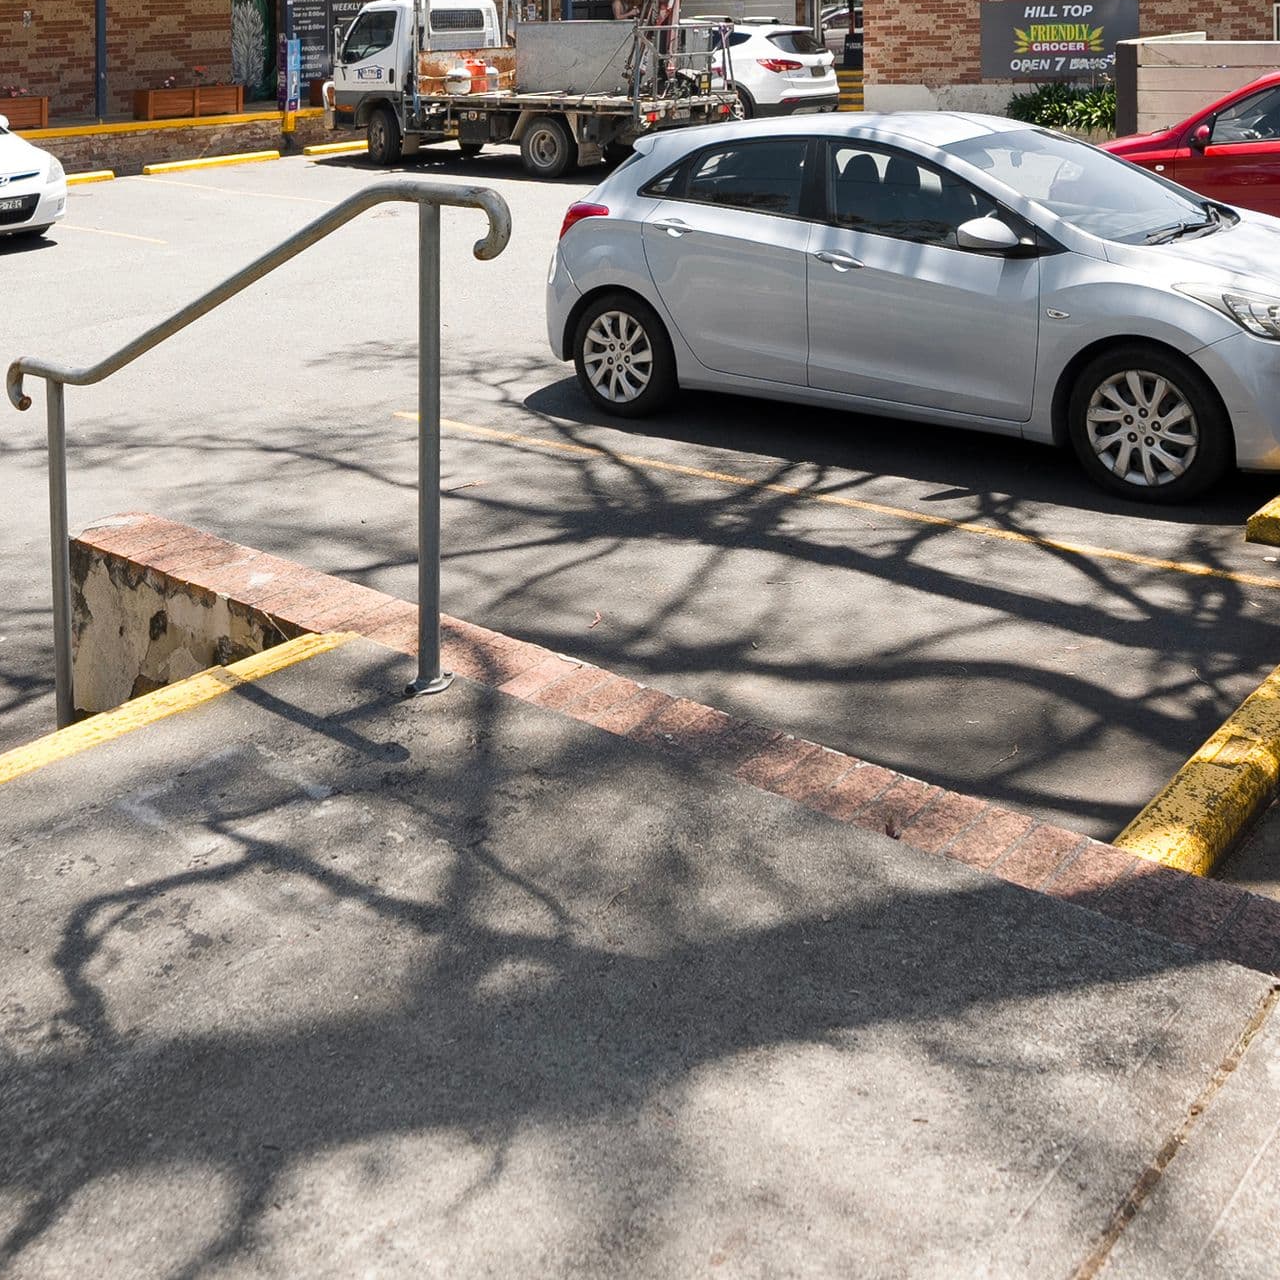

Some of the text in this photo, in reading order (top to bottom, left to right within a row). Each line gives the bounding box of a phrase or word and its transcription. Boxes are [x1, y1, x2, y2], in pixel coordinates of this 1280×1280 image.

[332, 2, 362, 12] WEEKLY
[1024, 4, 1094, 18] HILL TOP
[1029, 23, 1090, 42] FRIENDLY
[1032, 42, 1085, 52] GROCER
[1010, 59, 1051, 72] OPEN
[1054, 57, 1067, 71] 7
